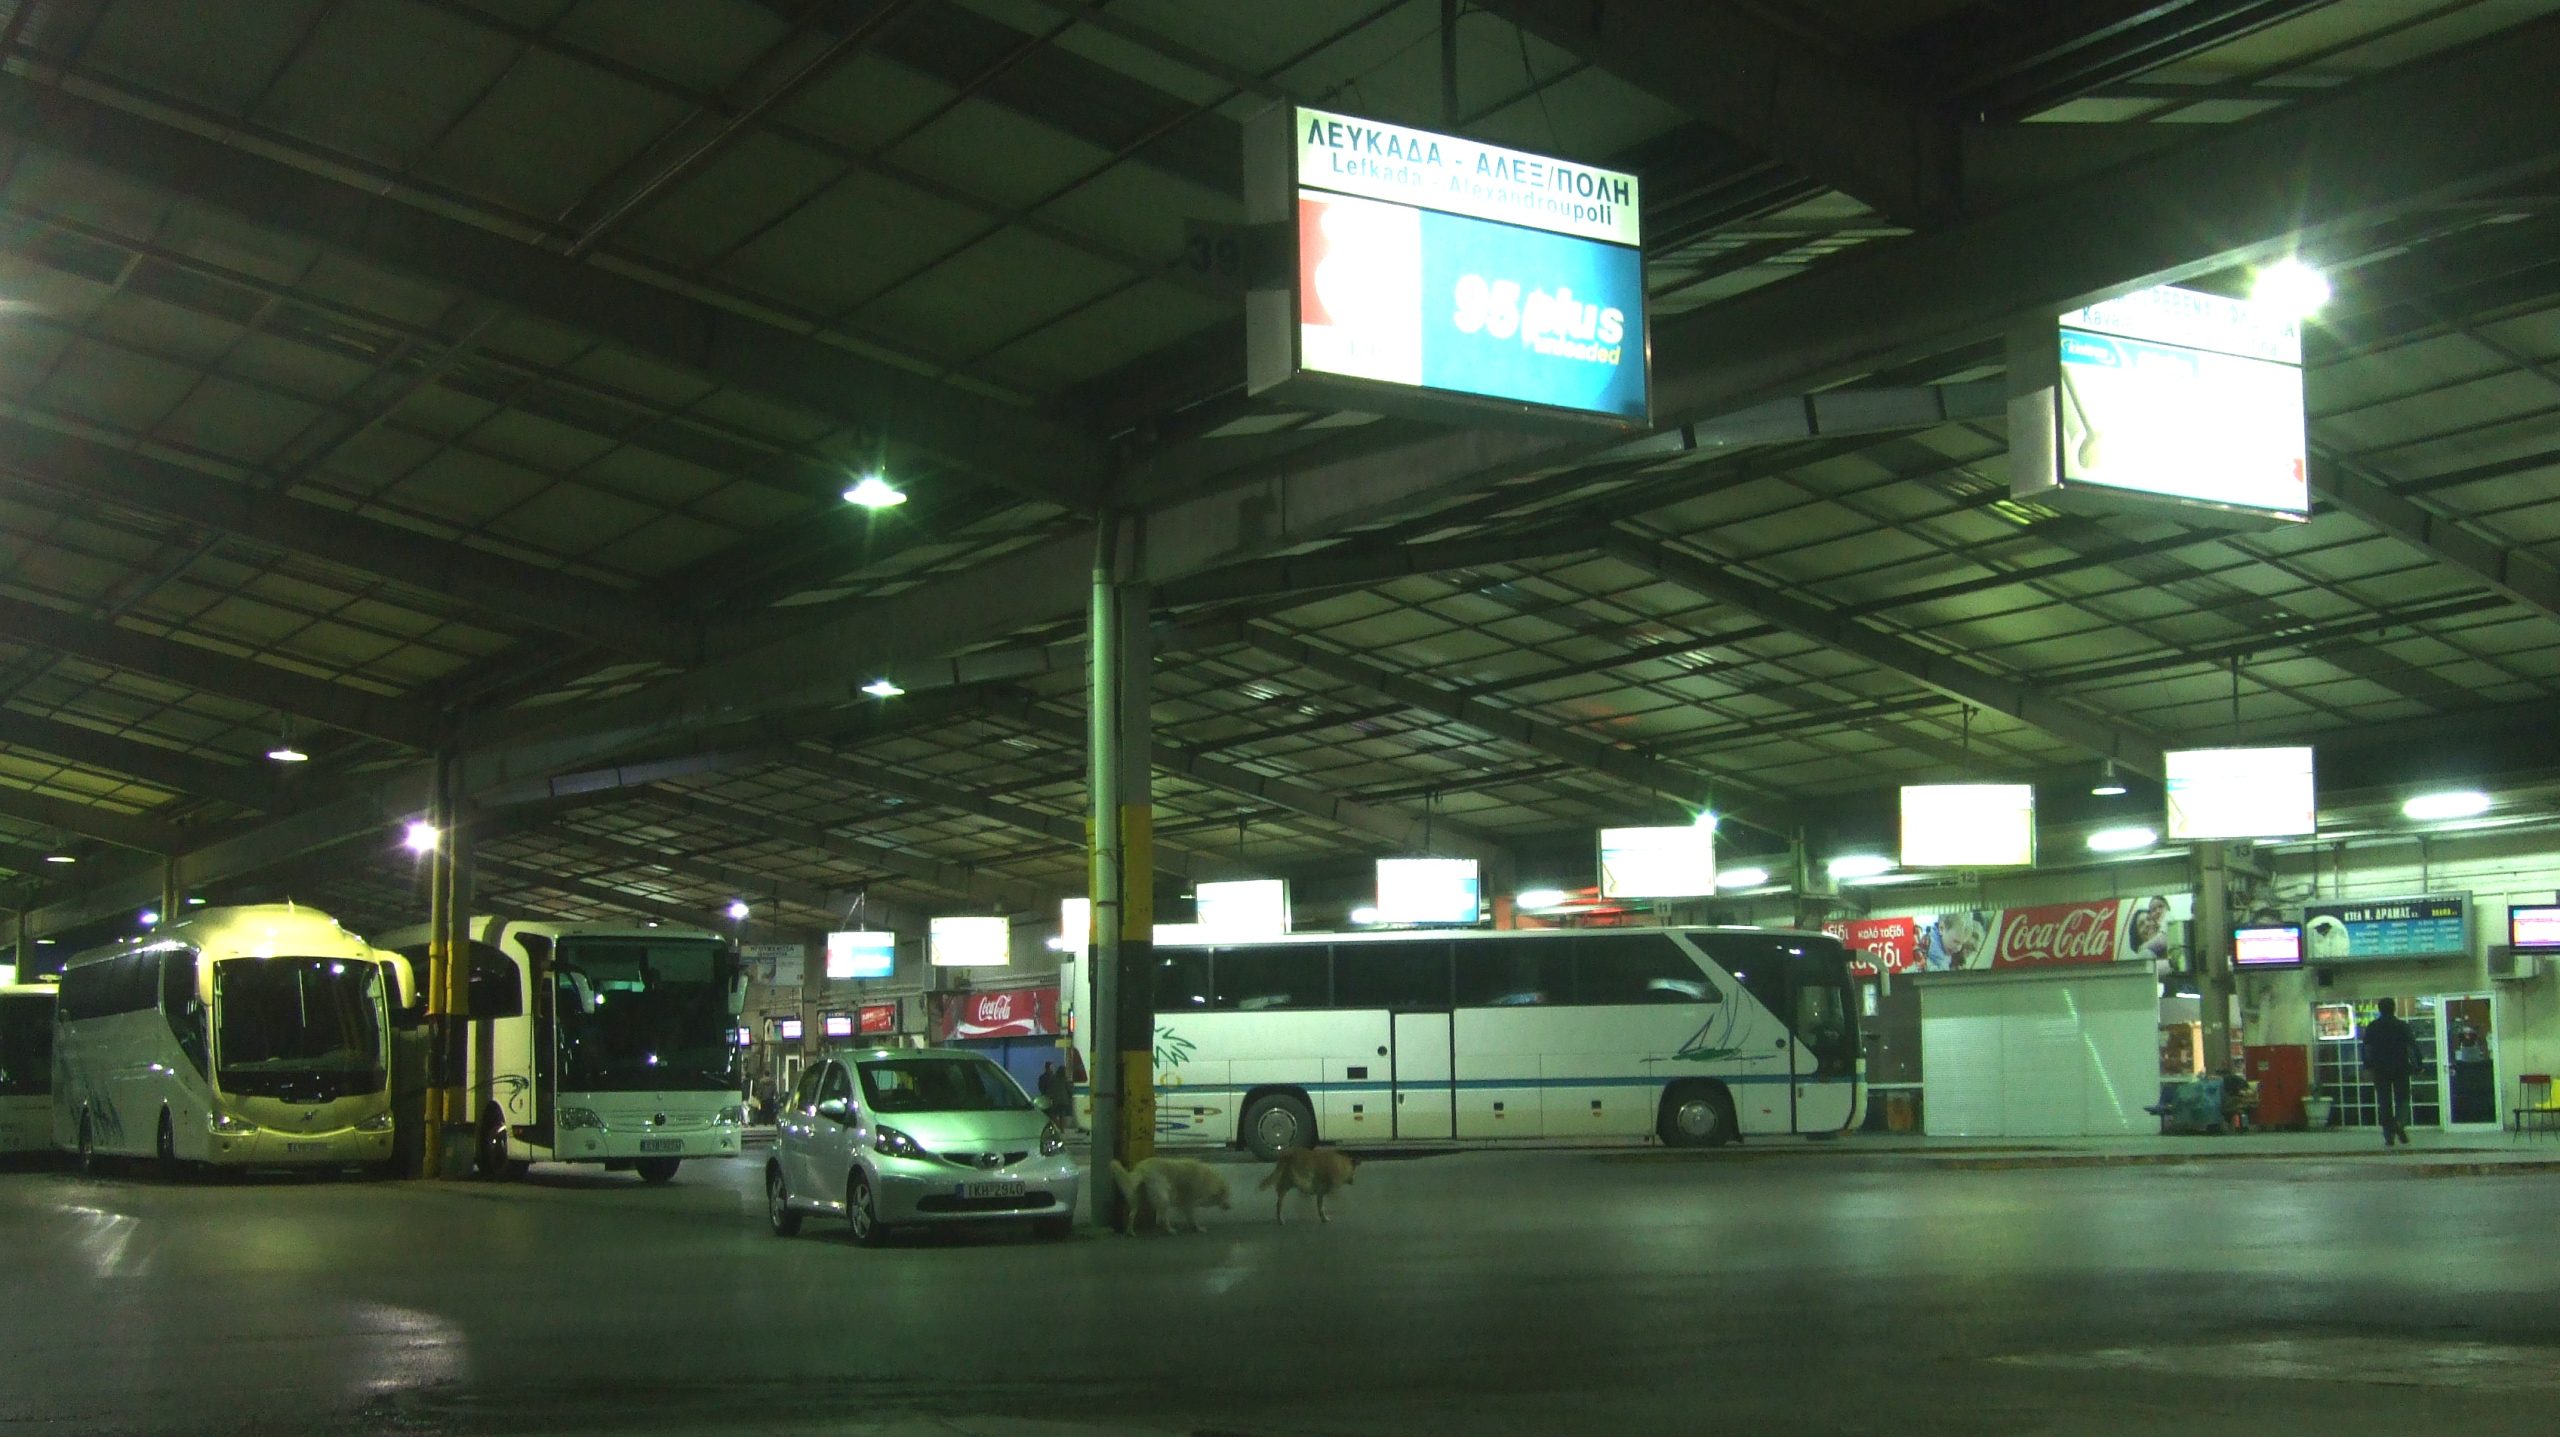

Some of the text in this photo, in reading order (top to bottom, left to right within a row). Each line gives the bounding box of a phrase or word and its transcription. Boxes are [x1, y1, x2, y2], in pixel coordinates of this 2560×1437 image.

[1307, 118, 1443, 168] ΛΕΥΚΑΔΑ
[1476, 151, 1630, 207] ΑΛΕΞ/ΠΟΛΗ
[1331, 152, 1422, 187] Lefkada
[1449, 175, 1612, 226] Alexandroupoli
[1454, 273, 1625, 349] 95 plus
[1960, 871, 1976, 883] 12
[1857, 924, 1905, 940] καλό ταξίδι
[2001, 908, 2114, 962] Coca-Cola
